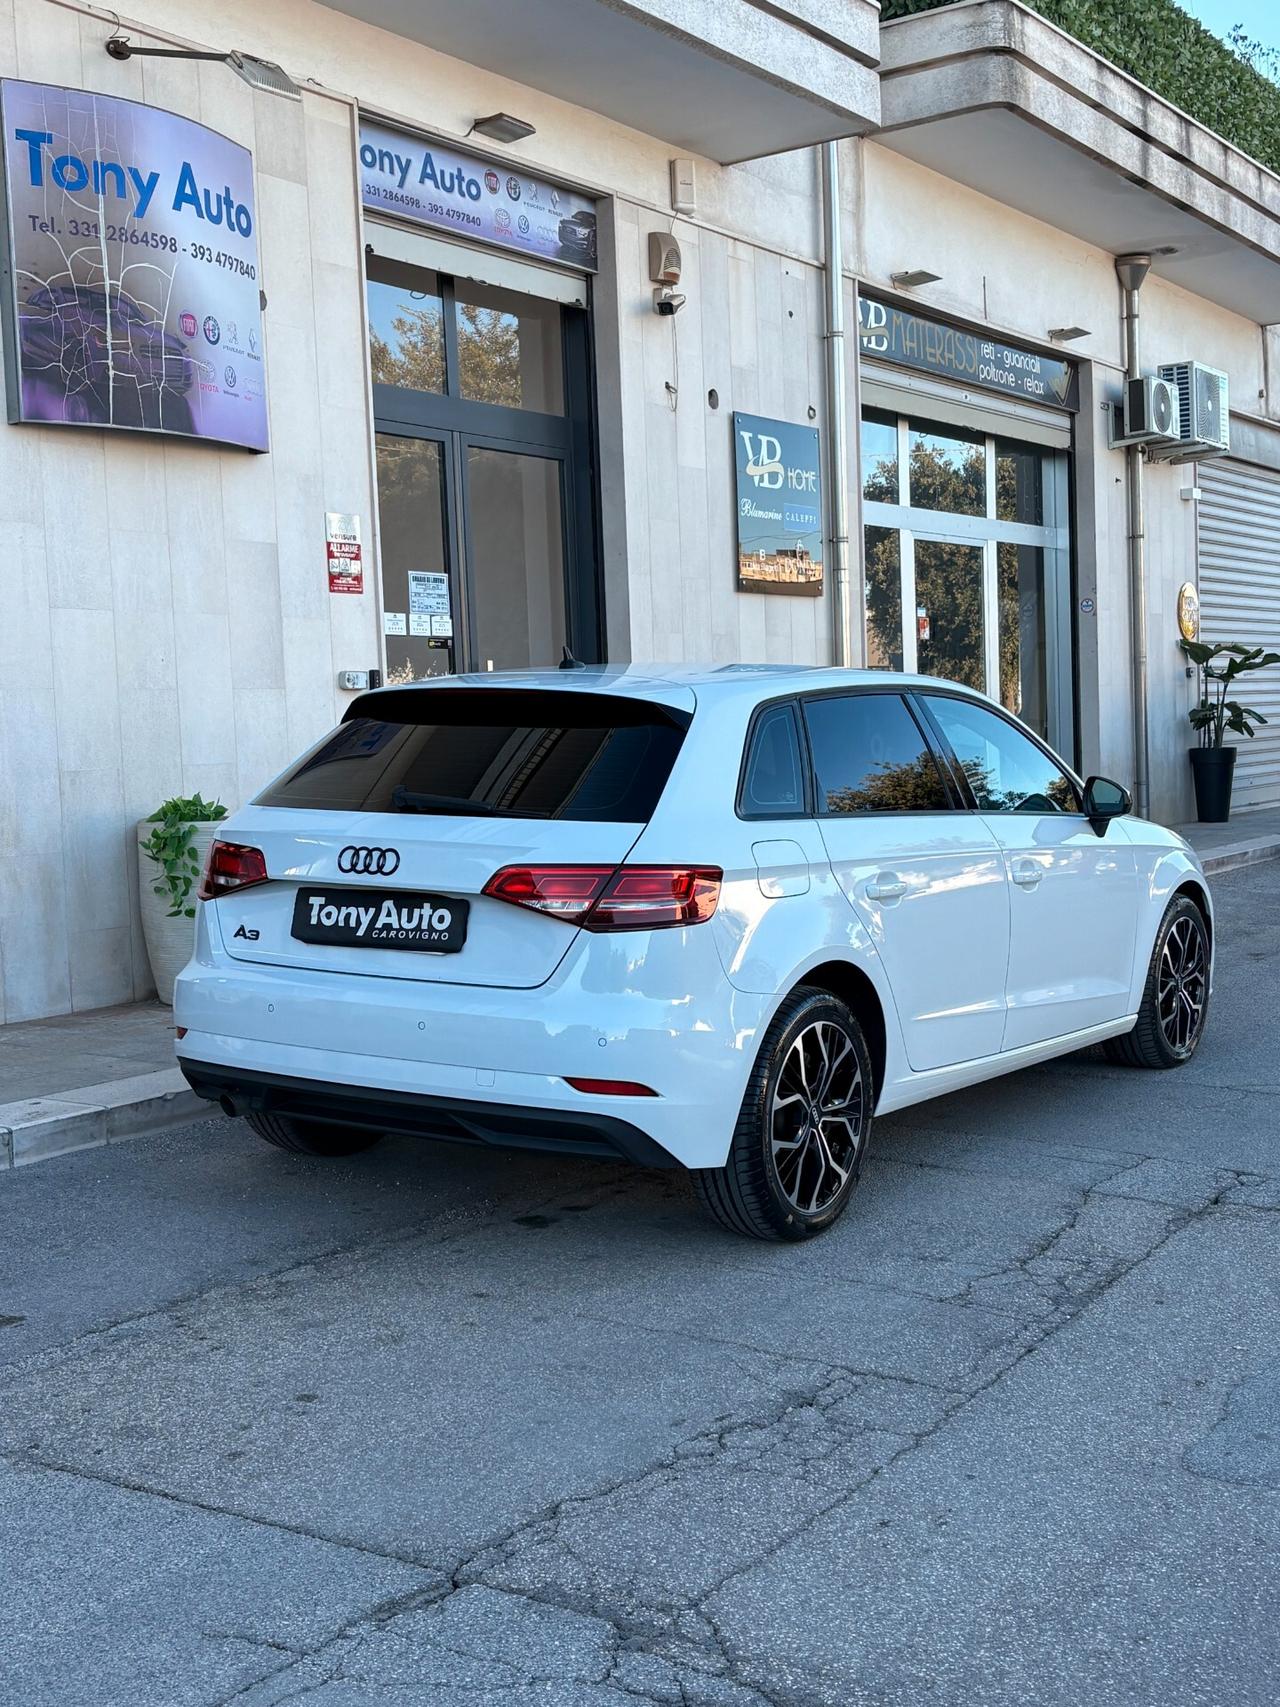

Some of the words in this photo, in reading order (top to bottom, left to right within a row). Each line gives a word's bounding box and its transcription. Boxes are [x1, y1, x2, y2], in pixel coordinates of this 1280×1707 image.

[15, 128, 160, 218] Tony
[172, 161, 252, 238] Auto
[360, 144, 412, 189] ony
[419, 152, 481, 201] Auto
[366, 184, 380, 197] 331
[383, 189, 420, 209] 2864598
[428, 203, 443, 216] 393
[446, 209, 481, 227] 4797840
[28, 214, 61, 234] Tel.
[69, 219, 99, 238] 331
[106, 225, 177, 253] 2864598
[190, 242, 213, 263] 393
[215, 251, 256, 281] 4797840
[892, 313, 979, 376] MATERASSI
[981, 342, 995, 360] reti
[1003, 351, 1041, 373] guanciali
[978, 364, 1015, 388] poltrone
[1023, 374, 1044, 394] relax
[787, 467, 817, 492] HOME
[330, 543, 359, 553] ALLARME
[233, 924, 260, 940] A3
[371, 929, 449, 941] CAROVIGNO
